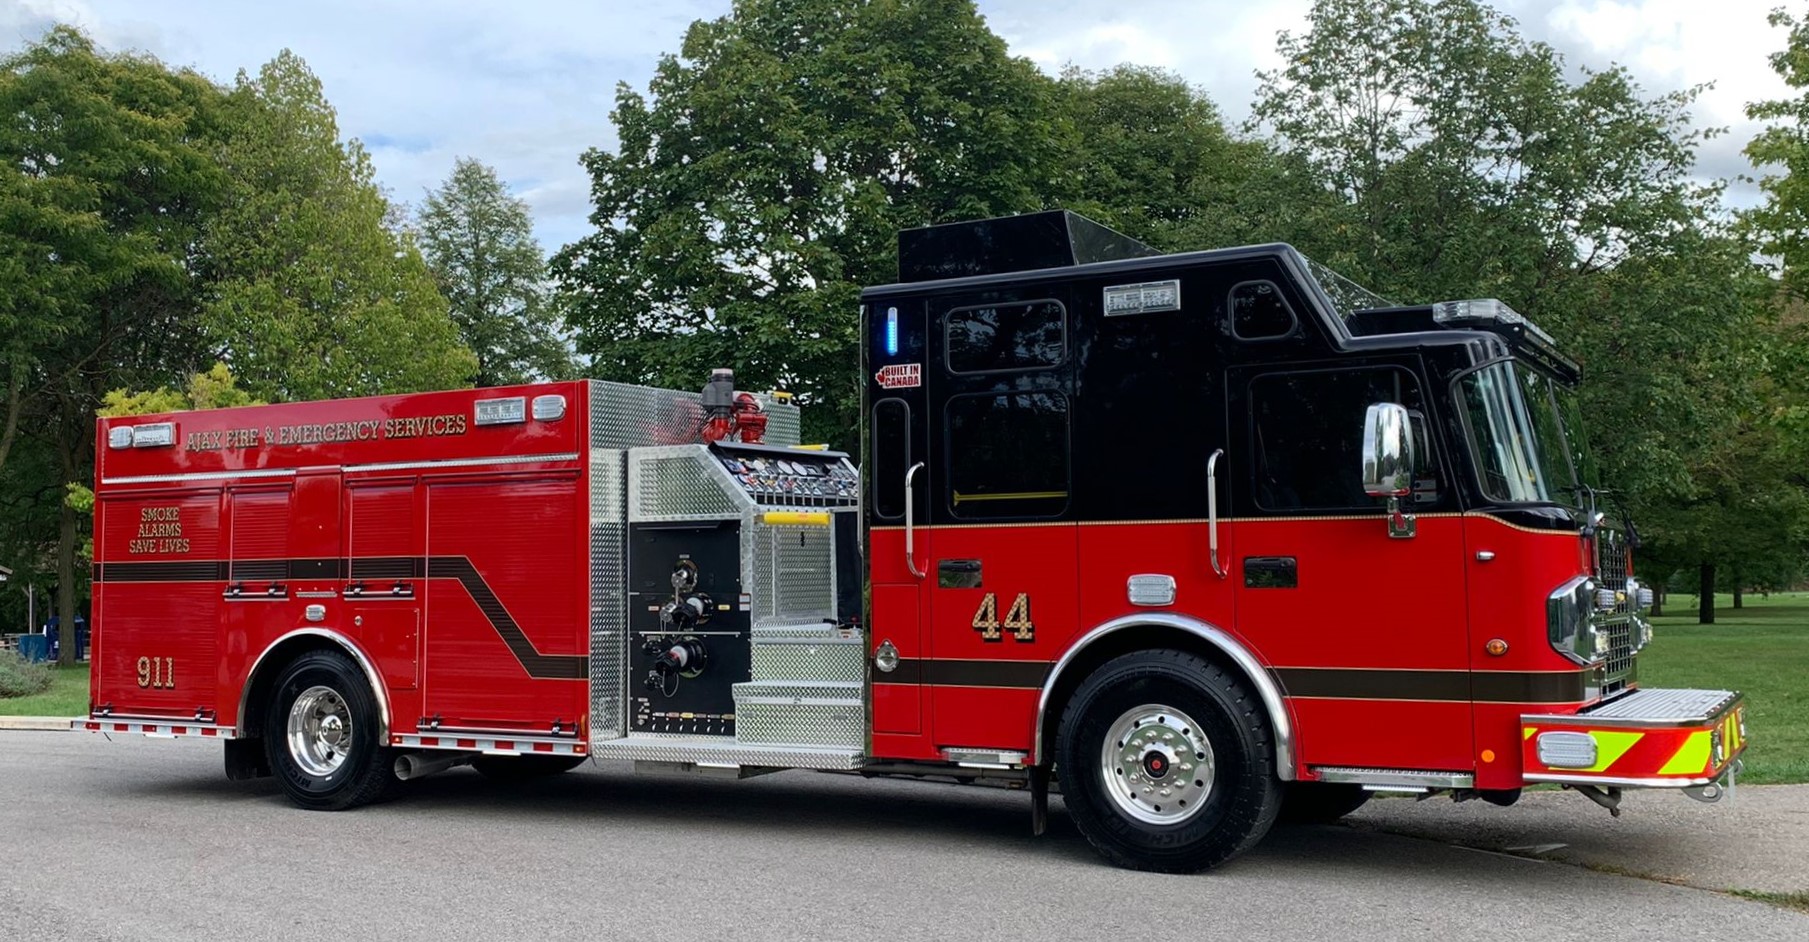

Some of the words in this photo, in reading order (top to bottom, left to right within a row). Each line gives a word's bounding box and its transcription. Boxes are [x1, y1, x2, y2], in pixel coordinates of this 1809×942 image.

[885, 366, 908, 376] BUILT
[910, 365, 919, 375] IN
[885, 376, 919, 387] CANADA
[185, 431, 222, 452] AJAX
[225, 428, 259, 449] FIRE
[264, 425, 275, 445] &
[279, 420, 380, 445] EMERGENCY
[384, 414, 467, 438] SERVICES
[141, 506, 180, 522] SMOKE
[137, 523, 182, 538] ALARMS
[129, 539, 157, 554] SAVE
[159, 538, 190, 553] LIVES
[972, 592, 1034, 641] 44
[137, 656, 175, 688] 911
